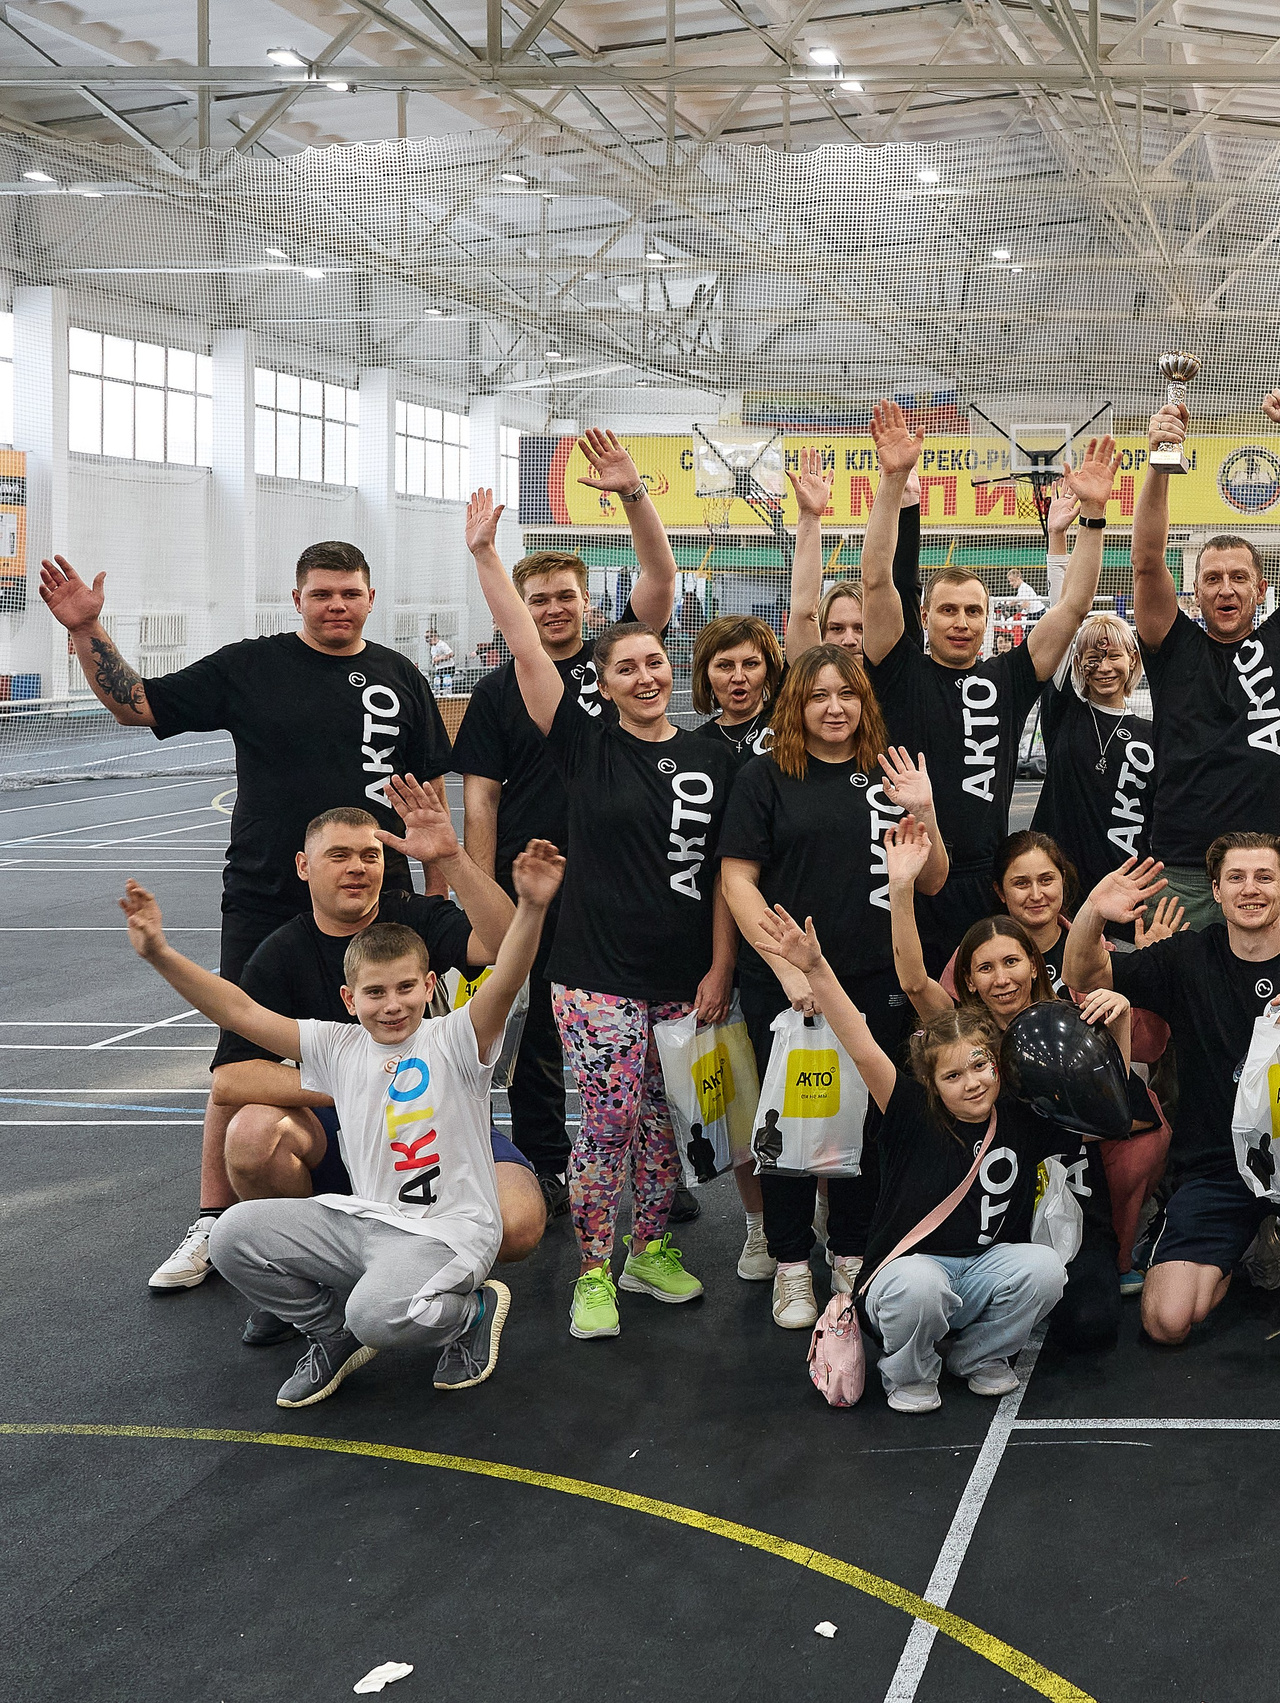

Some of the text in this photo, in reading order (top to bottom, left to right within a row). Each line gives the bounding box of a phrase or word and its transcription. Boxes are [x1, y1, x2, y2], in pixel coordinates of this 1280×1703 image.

[361, 684, 401, 809] АКТО
[962, 674, 1000, 803] АКТО
[1107, 741, 1155, 858] АКТО
[667, 771, 714, 901] АКТО
[386, 1056, 440, 1206] АКТО
[796, 1071, 833, 1087] АКТО
